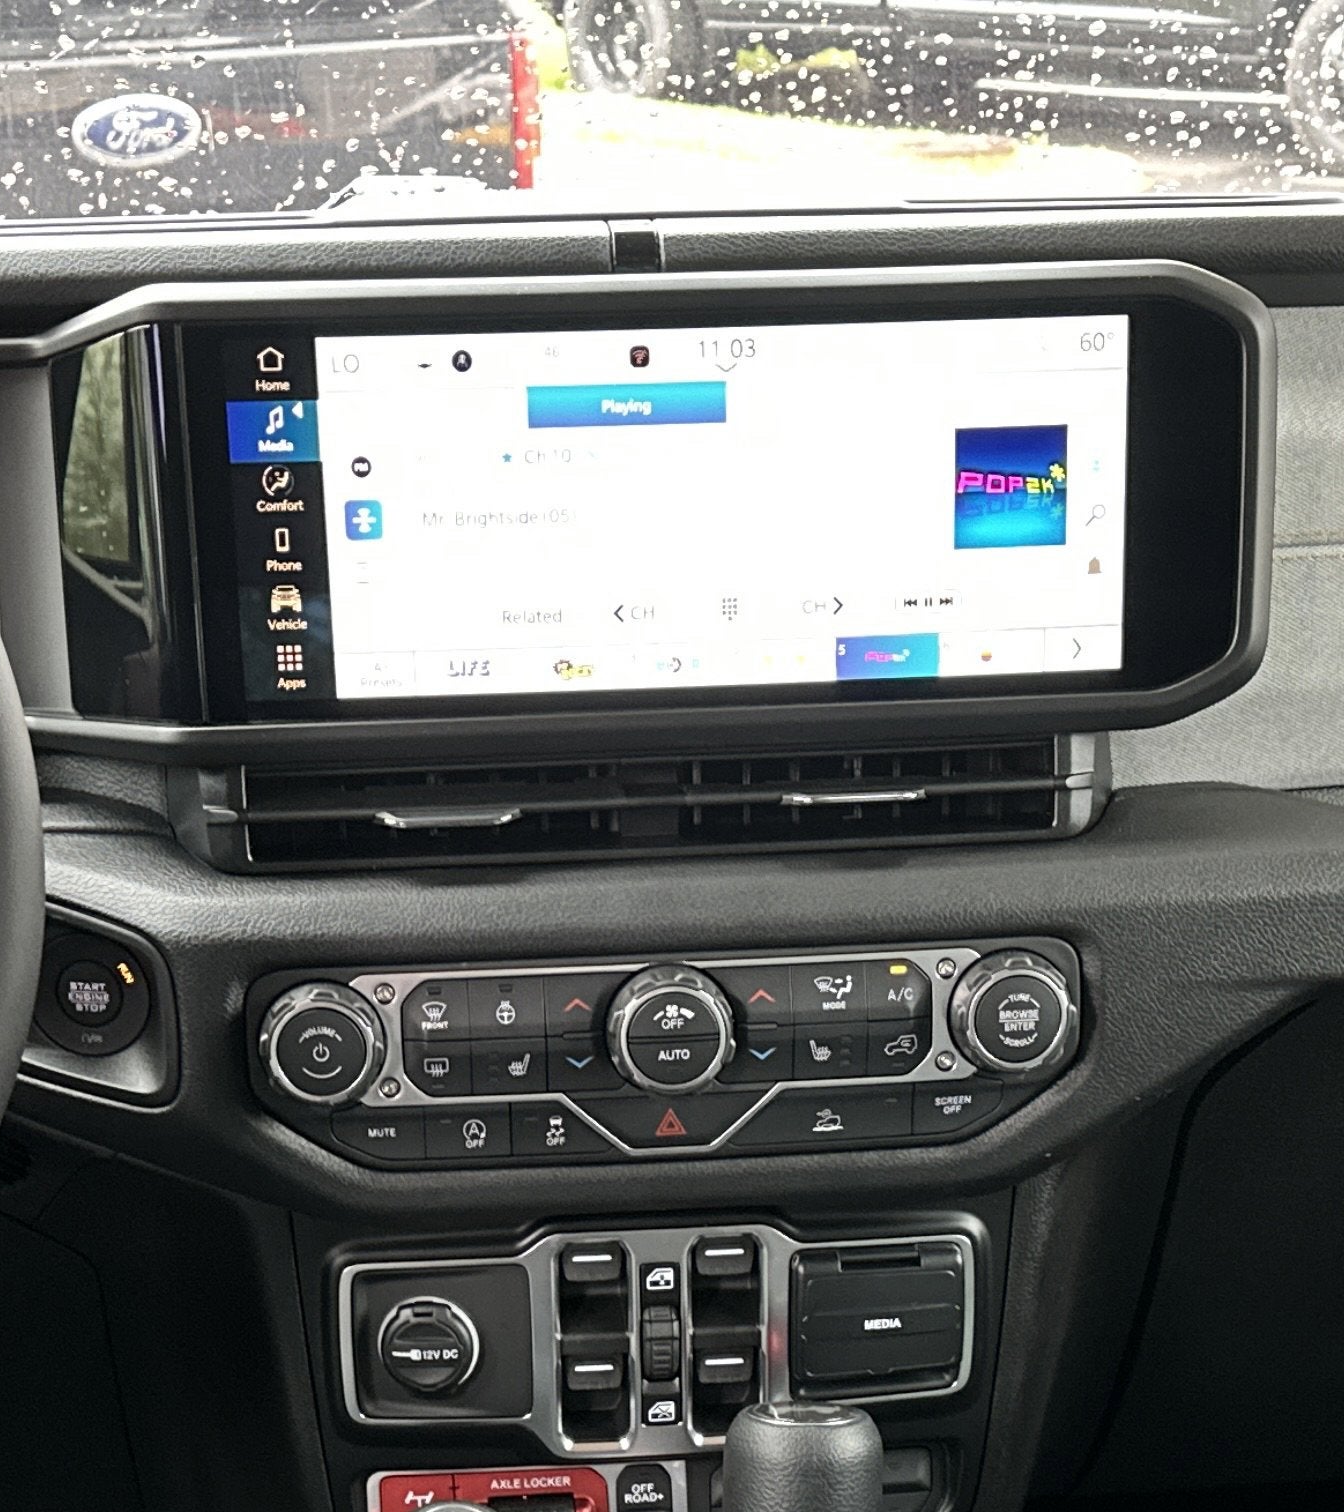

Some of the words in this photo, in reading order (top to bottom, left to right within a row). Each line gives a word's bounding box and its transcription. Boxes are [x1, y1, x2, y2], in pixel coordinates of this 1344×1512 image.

[103, 106, 178, 152] Ford
[1080, 331, 1115, 352] 60°
[699, 338, 756, 359] 1103
[331, 355, 360, 374] LO
[255, 379, 290, 393] Home
[601, 399, 652, 416] Playing
[258, 438, 294, 453] Media
[256, 498, 304, 513] Comfort
[266, 558, 303, 573] Phone
[502, 608, 563, 625] Related
[630, 606, 655, 621] CH
[267, 617, 308, 632] Vehicle
[838, 644, 846, 656] 5
[277, 677, 307, 692] Apps
[116, 962, 135, 984] RUN
[69, 981, 106, 991] START
[68, 991, 110, 1003] ENGINE
[887, 987, 914, 1003] A/C
[1007, 993, 1032, 1004] TUNE
[75, 1003, 107, 1013] STOP
[822, 1001, 846, 1010] MODE
[998, 1008, 1039, 1020] BROWSE
[421, 1019, 449, 1030] FRONT
[661, 1018, 685, 1031] OFF
[1003, 1021, 1036, 1032] ENTER
[303, 1026, 337, 1040] VOLUME
[1003, 1037, 1034, 1049] SCROLL
[657, 1048, 690, 1061] AUTO
[934, 1094, 972, 1106] SCREEN
[942, 1104, 962, 1115] OFF
[367, 1127, 396, 1138] MUTE
[465, 1138, 485, 1150] OFF
[546, 1136, 566, 1147] OFF
[863, 1317, 902, 1331] MEDIA
[422, 1348, 442, 1361] 12V
[443, 1347, 459, 1361] DC
[490, 1476, 520, 1490] AXLE
[522, 1474, 572, 1489] LOCKER
[631, 1483, 655, 1494] OFF
[624, 1491, 665, 1503] ROAD+
